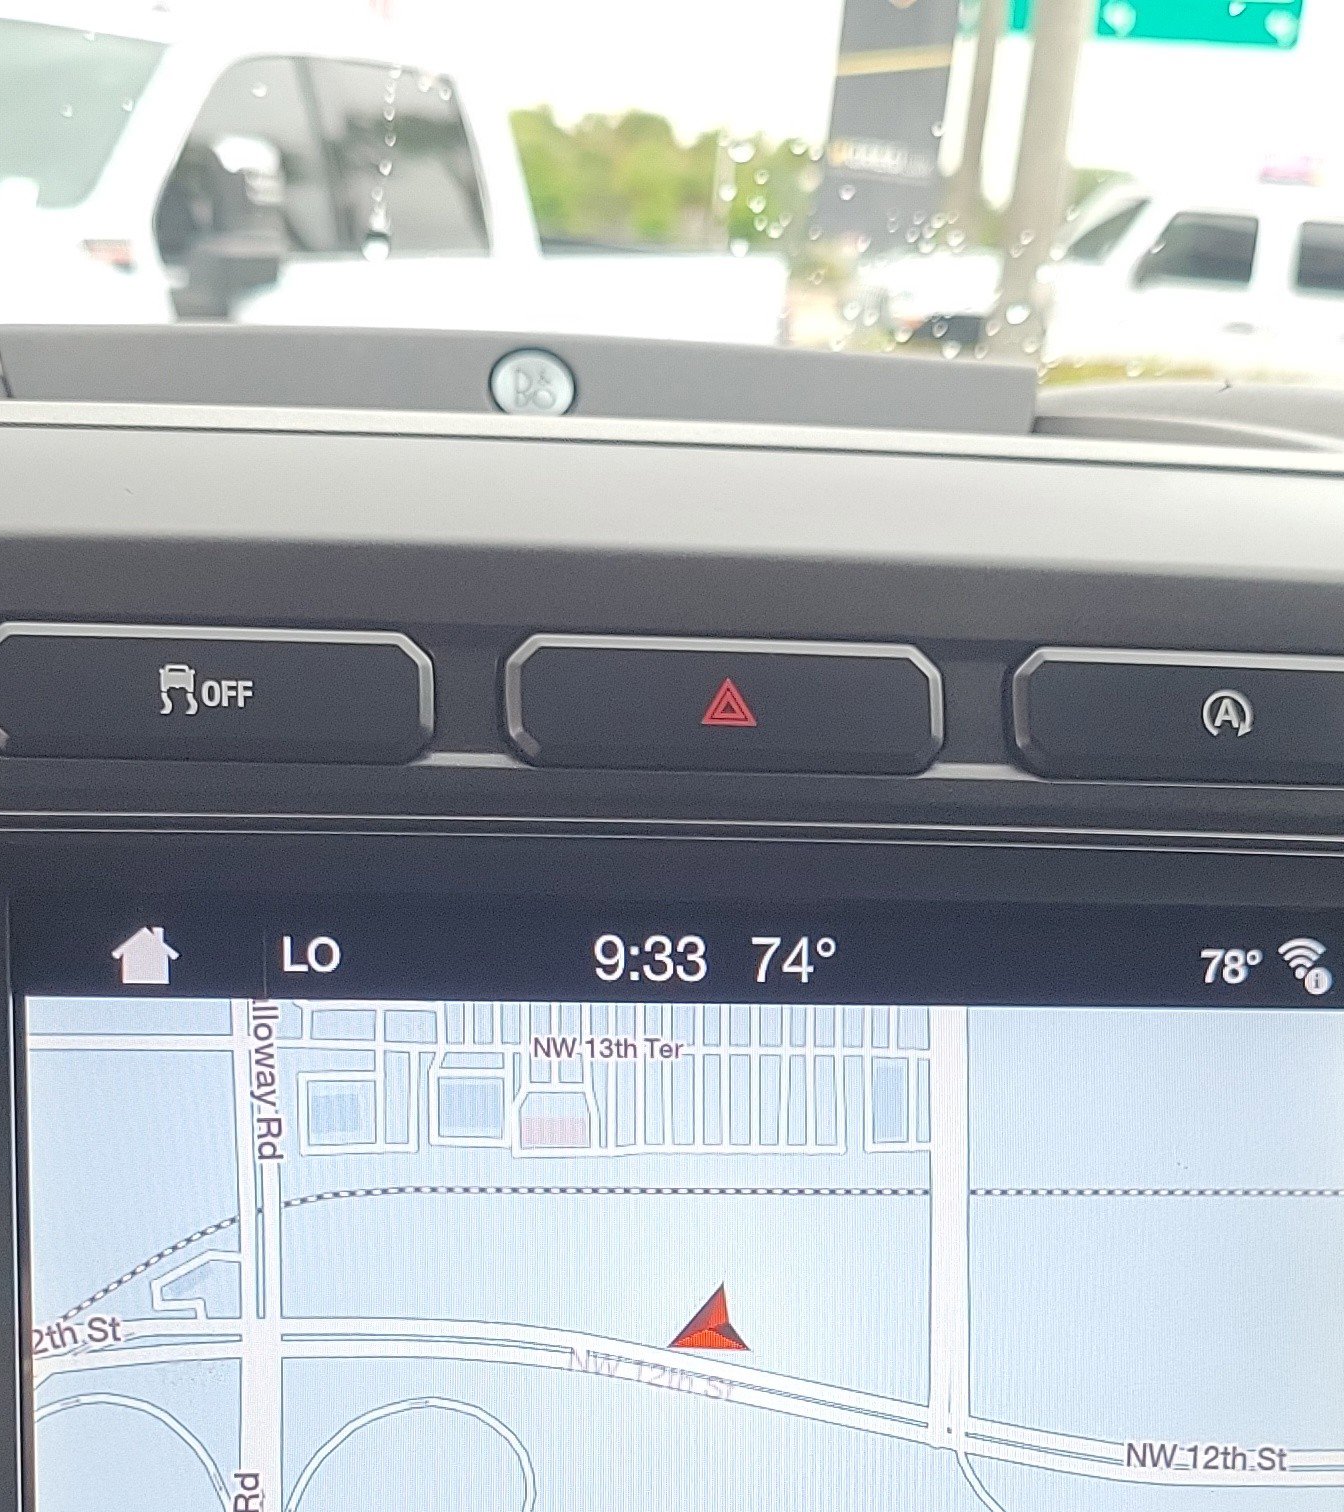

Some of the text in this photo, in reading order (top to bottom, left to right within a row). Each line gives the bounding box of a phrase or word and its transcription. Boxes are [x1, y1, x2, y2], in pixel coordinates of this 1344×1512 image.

[201, 680, 253, 708] OFF
[282, 935, 341, 974] LO
[594, 934, 707, 982] 9:33
[751, 936, 837, 983] 74°
[1200, 948, 1263, 984] 78°
[533, 1037, 684, 1059] NW 13th Ter
[250, 1000, 284, 1160] lloway Rd
[87, 1316, 122, 1343] St
[1126, 1442, 1288, 1471] NW 12th St
